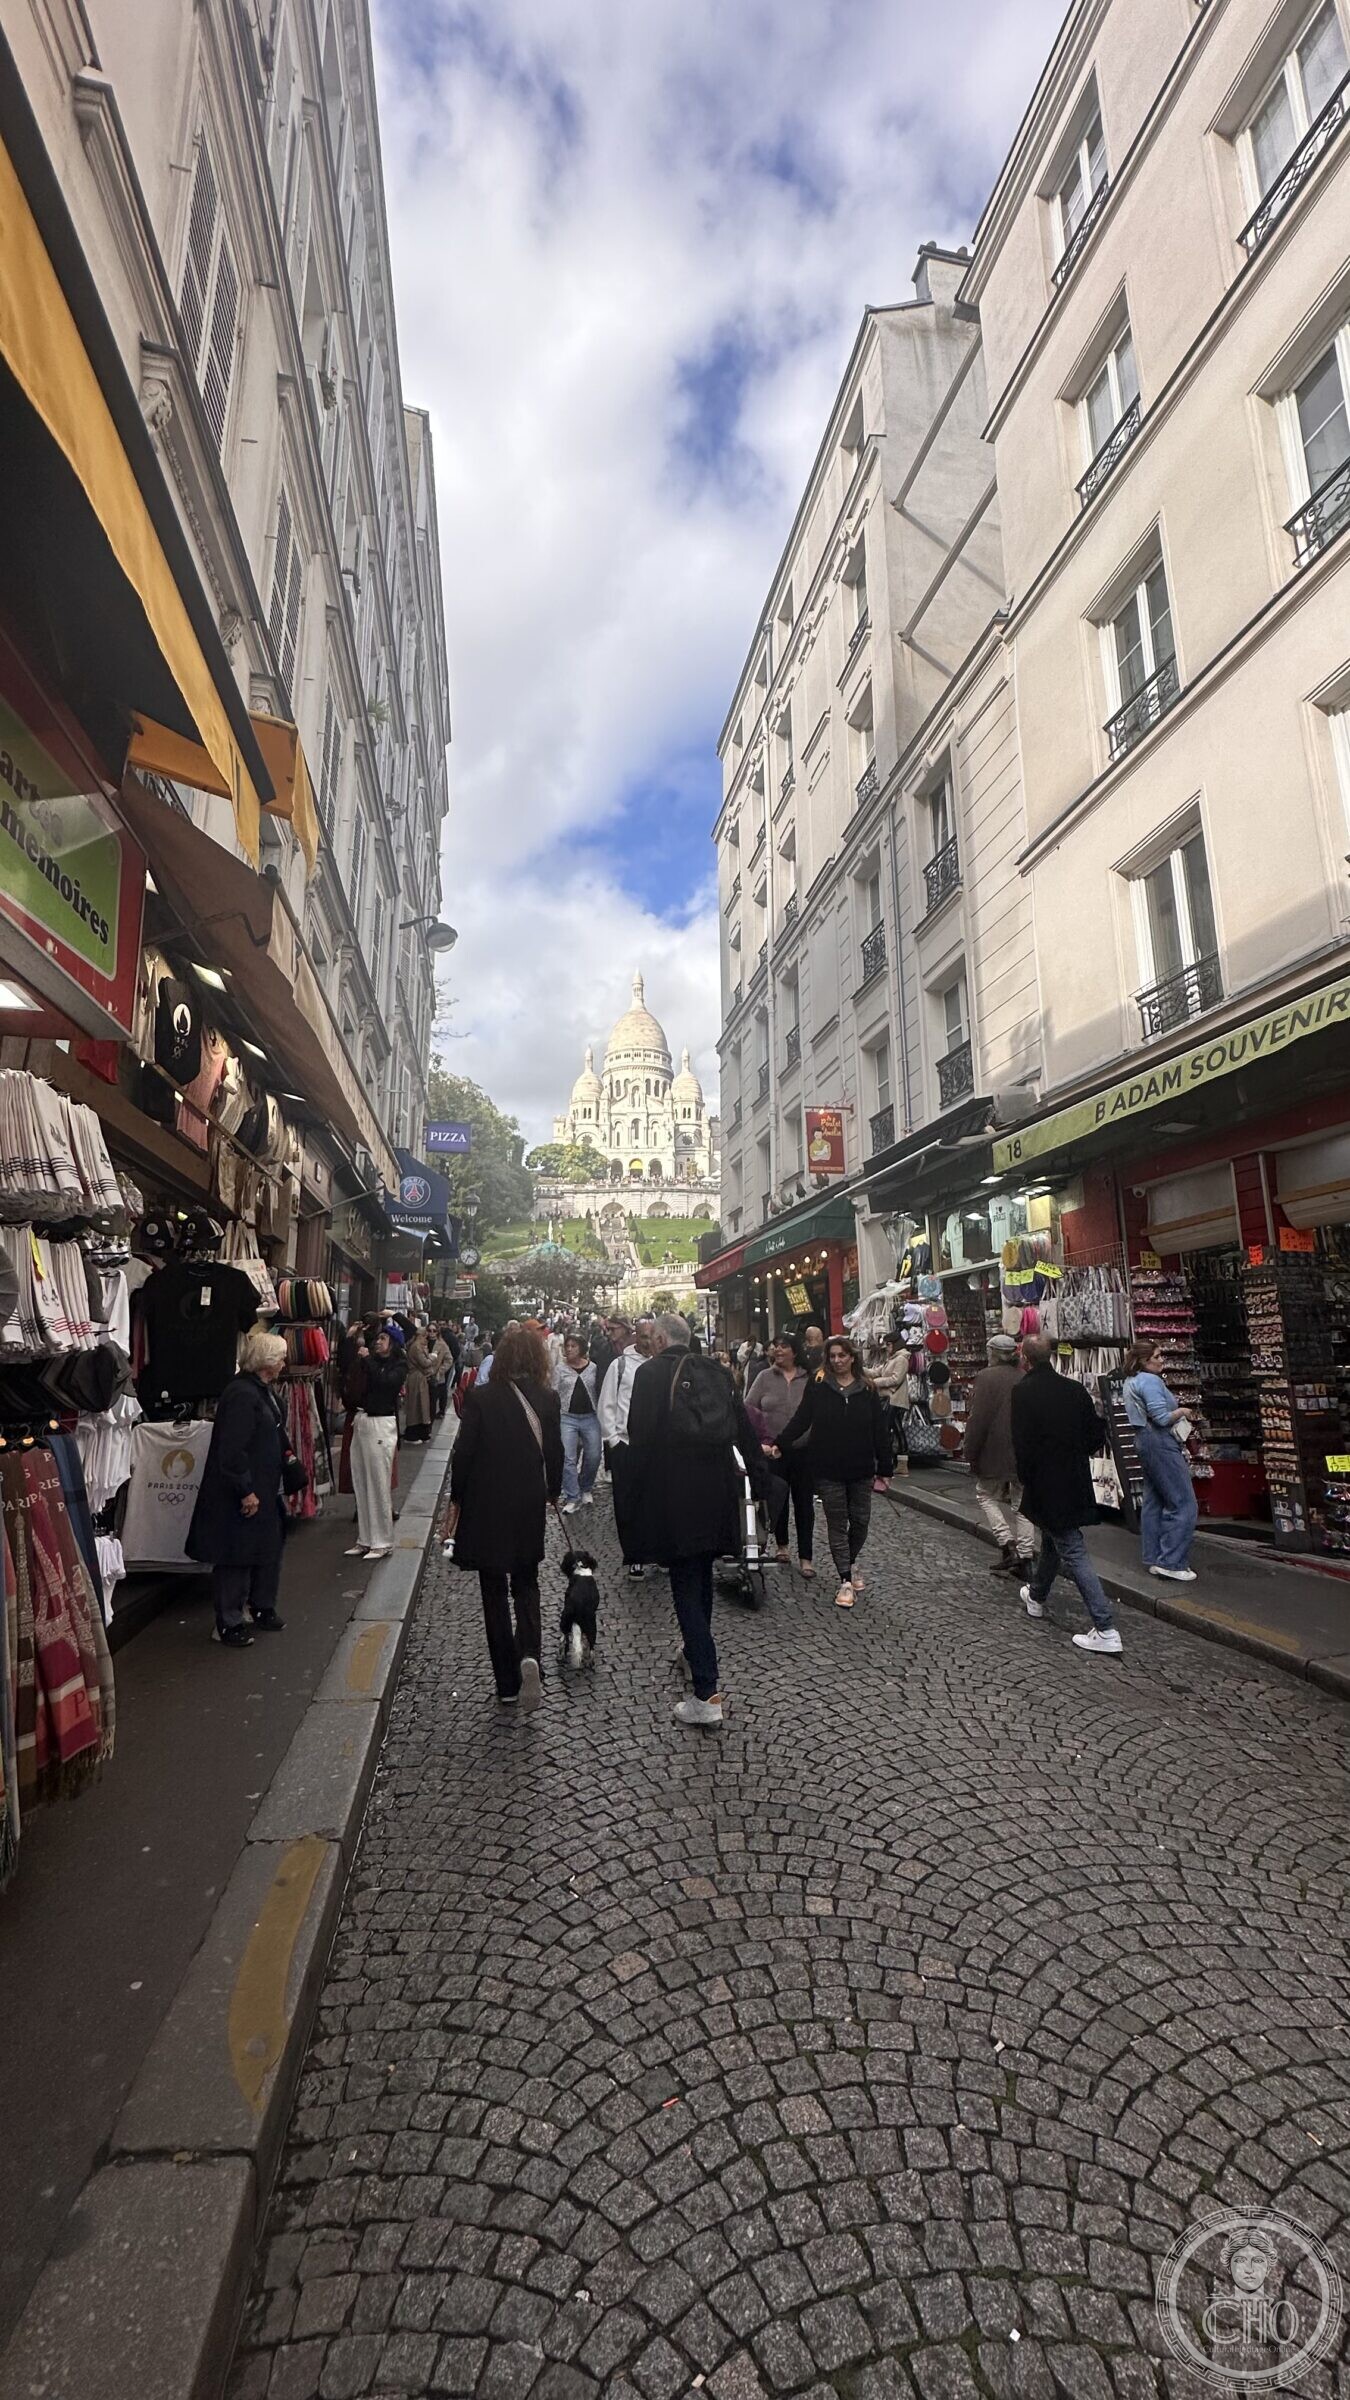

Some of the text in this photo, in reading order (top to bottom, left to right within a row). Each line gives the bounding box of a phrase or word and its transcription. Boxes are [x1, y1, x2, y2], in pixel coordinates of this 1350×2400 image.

[430, 1131, 467, 1142] PIZZA
[1007, 1139, 1022, 1162] 18
[391, 1214, 433, 1223] Welcome
[147, 1482, 174, 1490] PARIS
